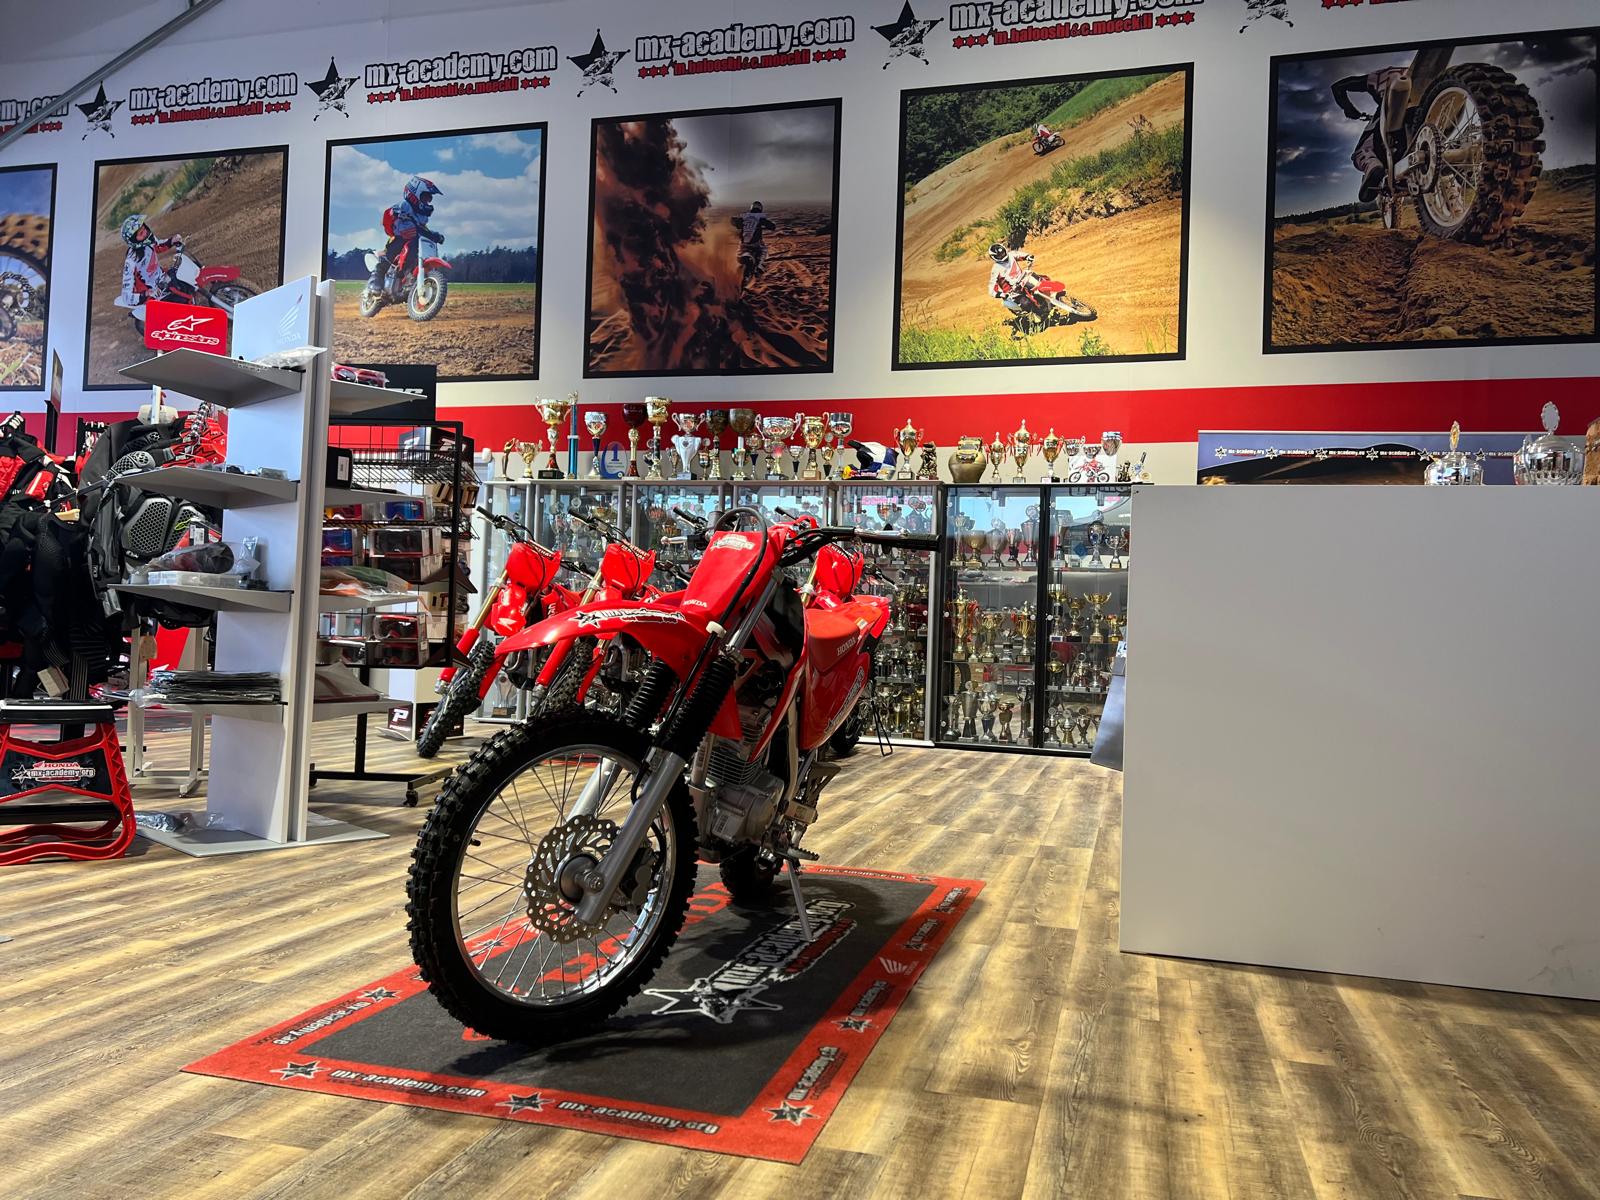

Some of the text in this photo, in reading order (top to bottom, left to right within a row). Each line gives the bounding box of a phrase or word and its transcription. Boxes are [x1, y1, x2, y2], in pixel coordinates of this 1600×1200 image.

[950, 0, 1204, 31] mx-academy.
[635, 16, 855, 62] mx-academy.com
[365, 46, 558, 89] mx-academy.com
[129, 72, 298, 111] mx-academy.com
[150, 330, 220, 346] alpinestars
[837, 637, 856, 656] HONDA
[29, 768, 95, 778] mx-academy.org
[328, 1068, 488, 1098] mx-academy.com
[556, 1100, 721, 1135] mx-academy.org
